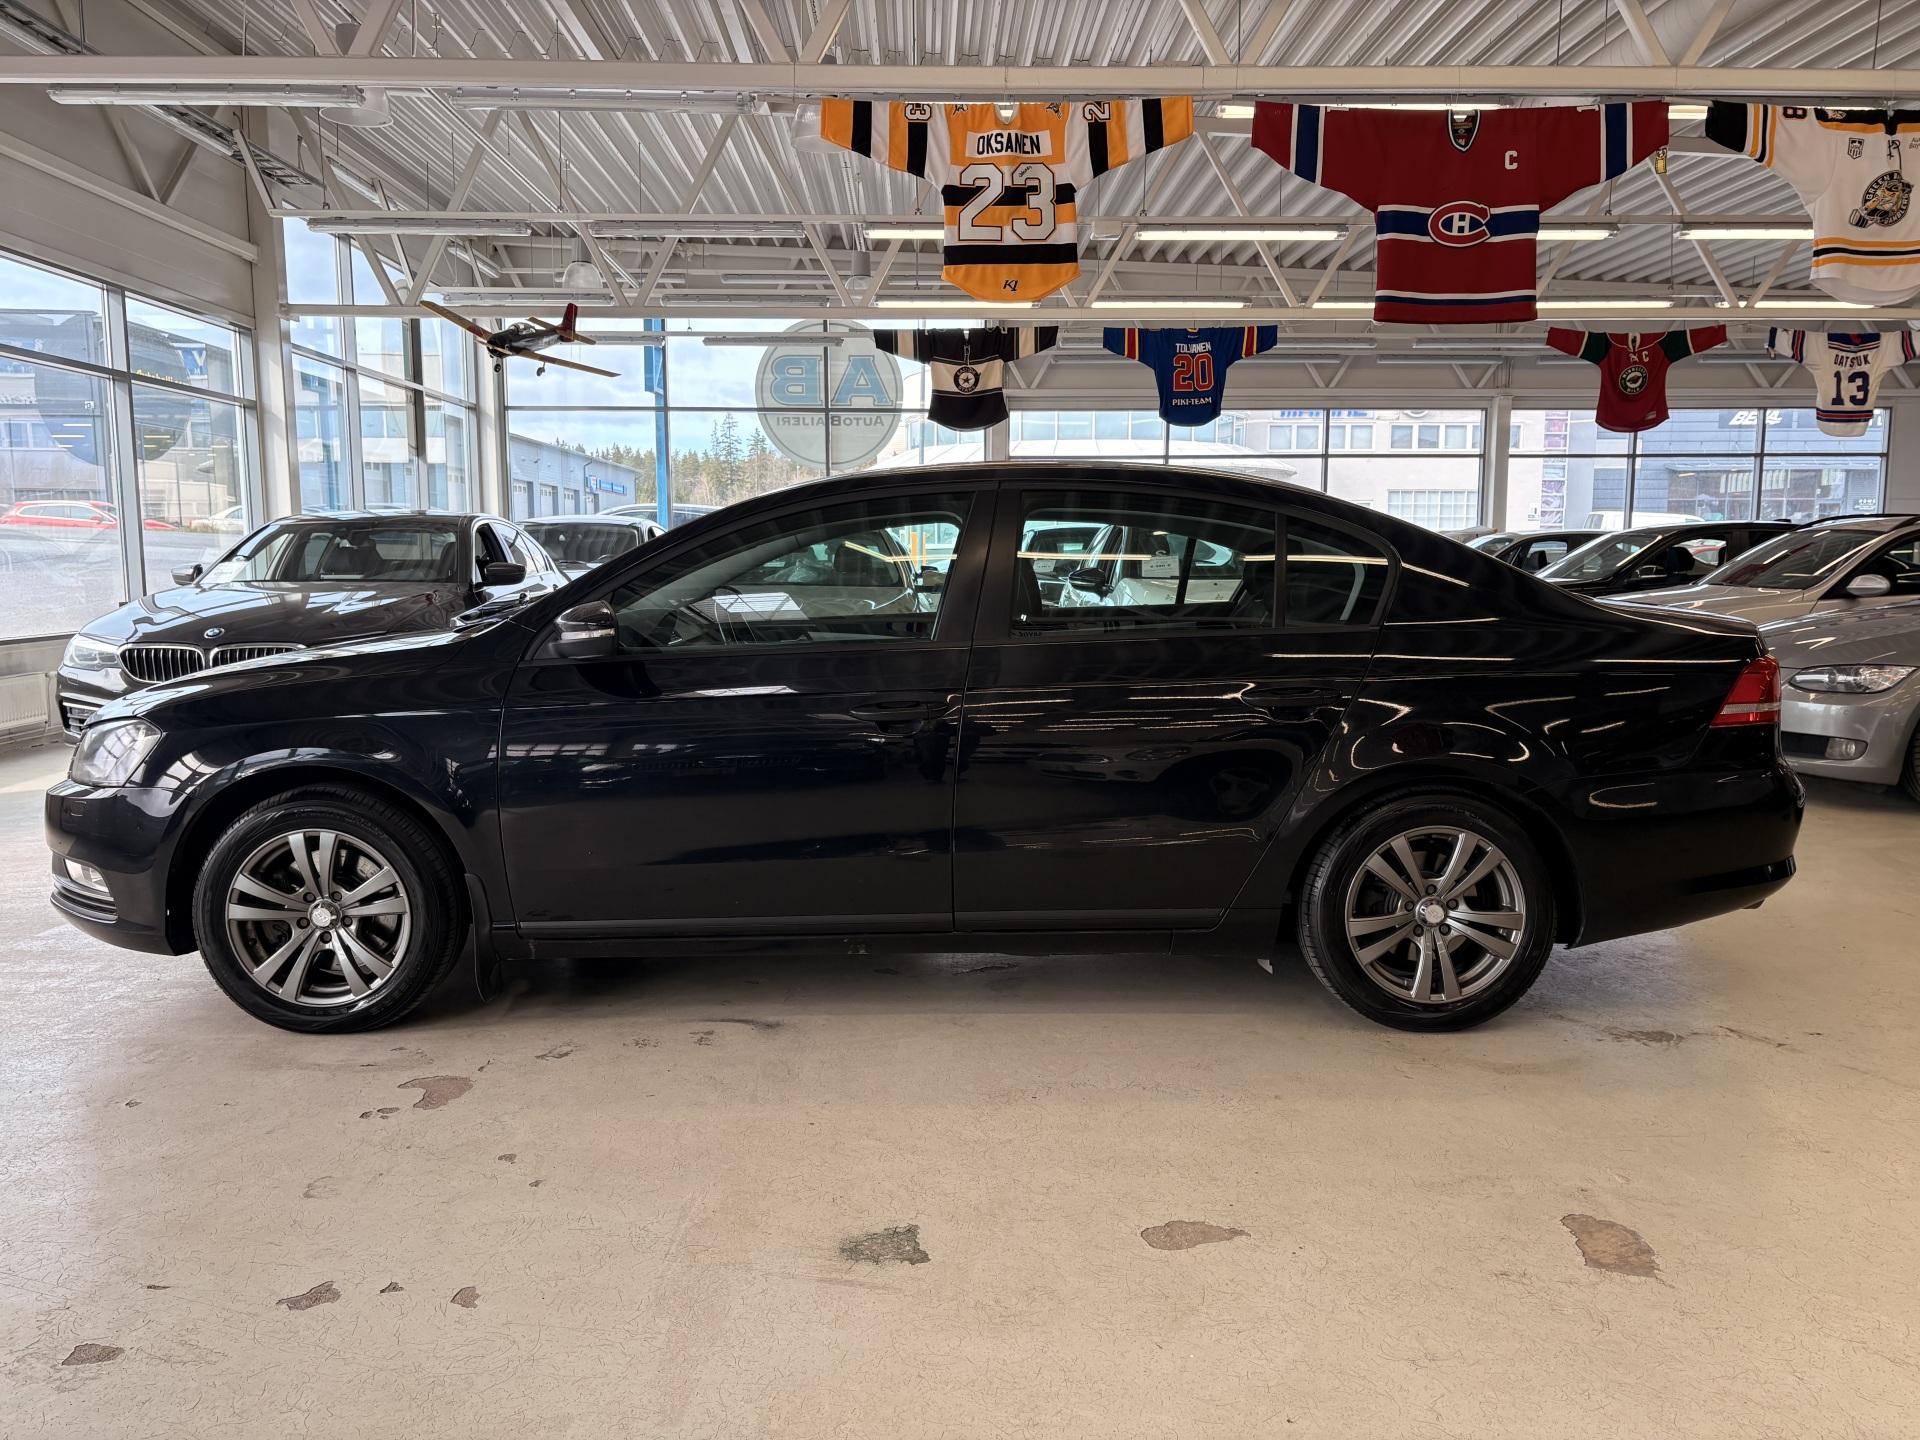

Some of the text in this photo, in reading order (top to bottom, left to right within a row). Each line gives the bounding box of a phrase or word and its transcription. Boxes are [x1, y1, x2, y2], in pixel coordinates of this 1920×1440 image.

[976, 132, 1041, 155] OKSANEN
[1504, 150, 1519, 170] C
[958, 162, 1057, 242] 23
[1175, 341, 1212, 354] TOLVANEN
[1173, 352, 1215, 392] 20
[1831, 370, 1870, 406] 13
[1172, 397, 1212, 406] PIKI-TEAM
